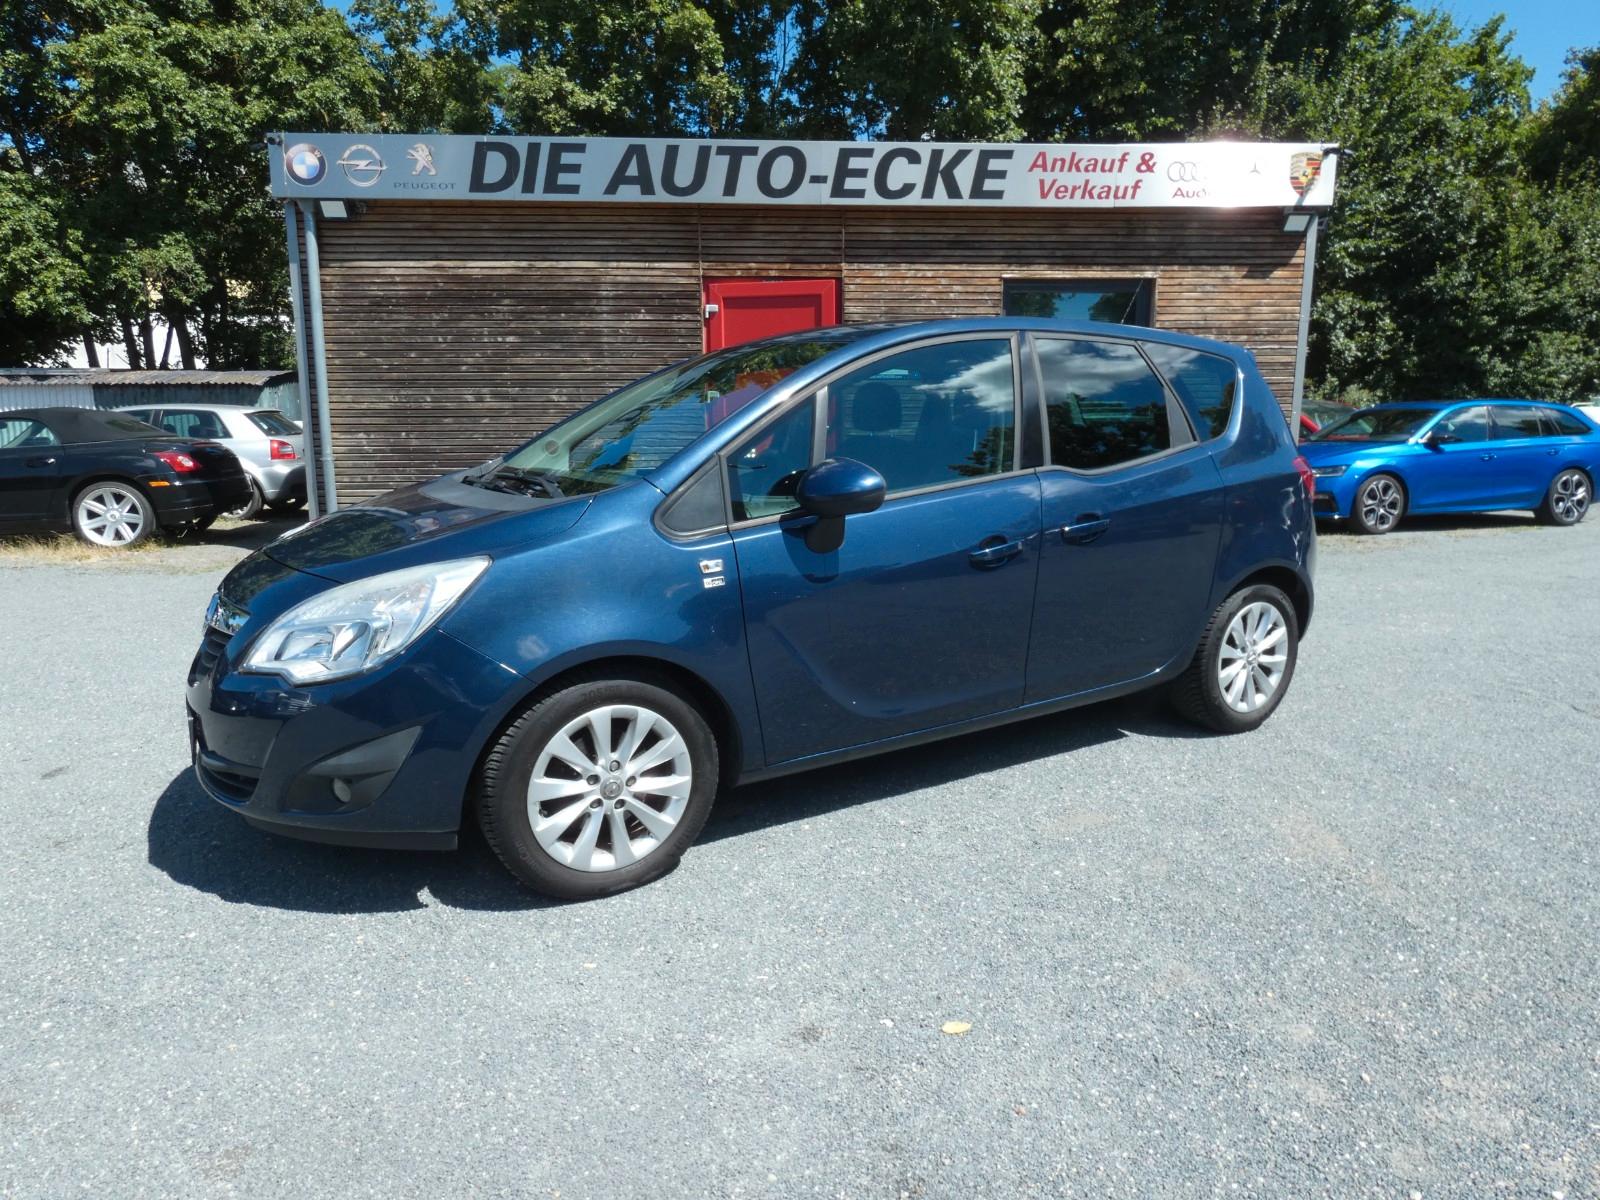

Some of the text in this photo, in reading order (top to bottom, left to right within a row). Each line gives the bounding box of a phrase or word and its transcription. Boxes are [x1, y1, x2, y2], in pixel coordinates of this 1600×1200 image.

[468, 141, 1015, 200] DIE AUTO-ECKE
[1028, 151, 1156, 174] Ankauf &
[393, 182, 456, 190] PEUGEOT
[1038, 178, 1142, 200] Verkauf
